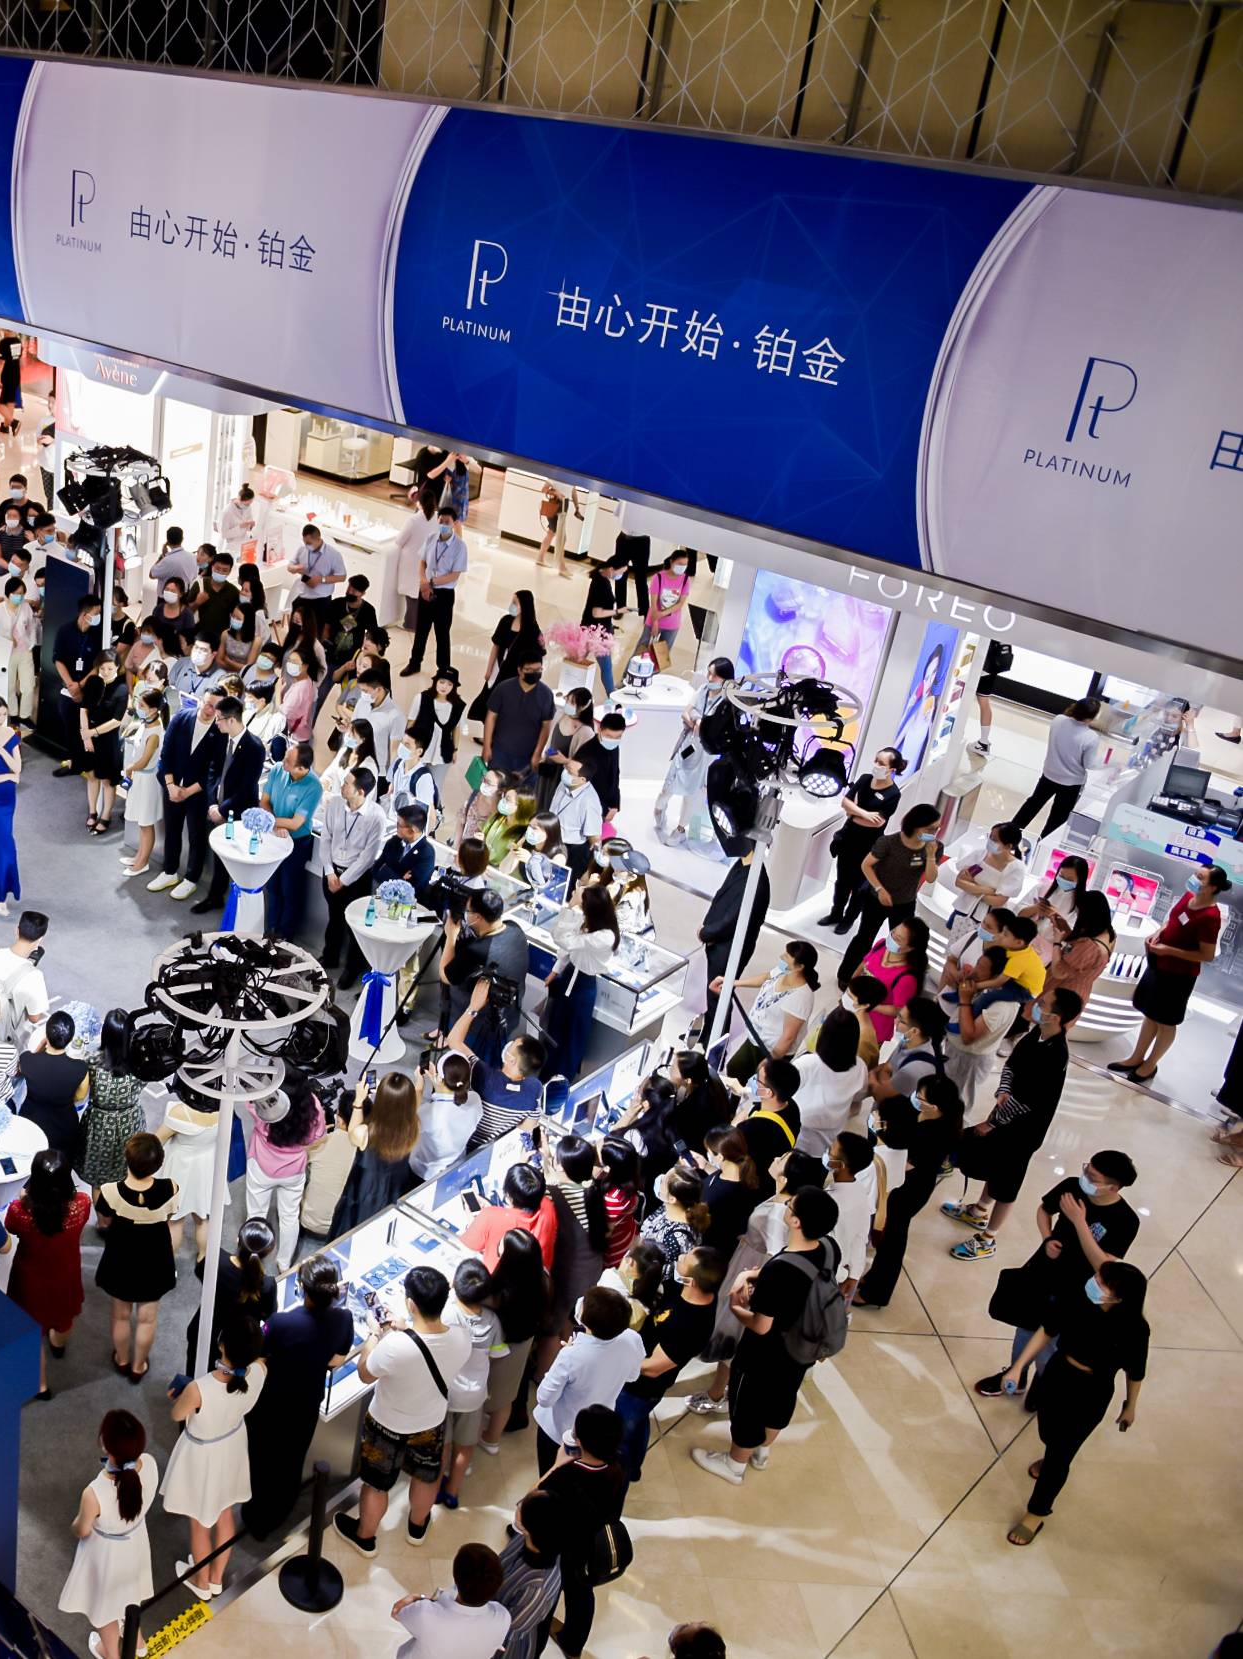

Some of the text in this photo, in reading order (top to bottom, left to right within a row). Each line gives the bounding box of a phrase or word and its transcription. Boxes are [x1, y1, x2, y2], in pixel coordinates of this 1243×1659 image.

[55, 233, 102, 253] PLATINUM
[128, 203, 317, 274] 由心开始·铂金
[442, 315, 511, 344] PLATINUM
[554, 284, 847, 387] 由心开始·铂金
[1023, 448, 1132, 488] PLATINUM
[847, 566, 1016, 632] FOREO
